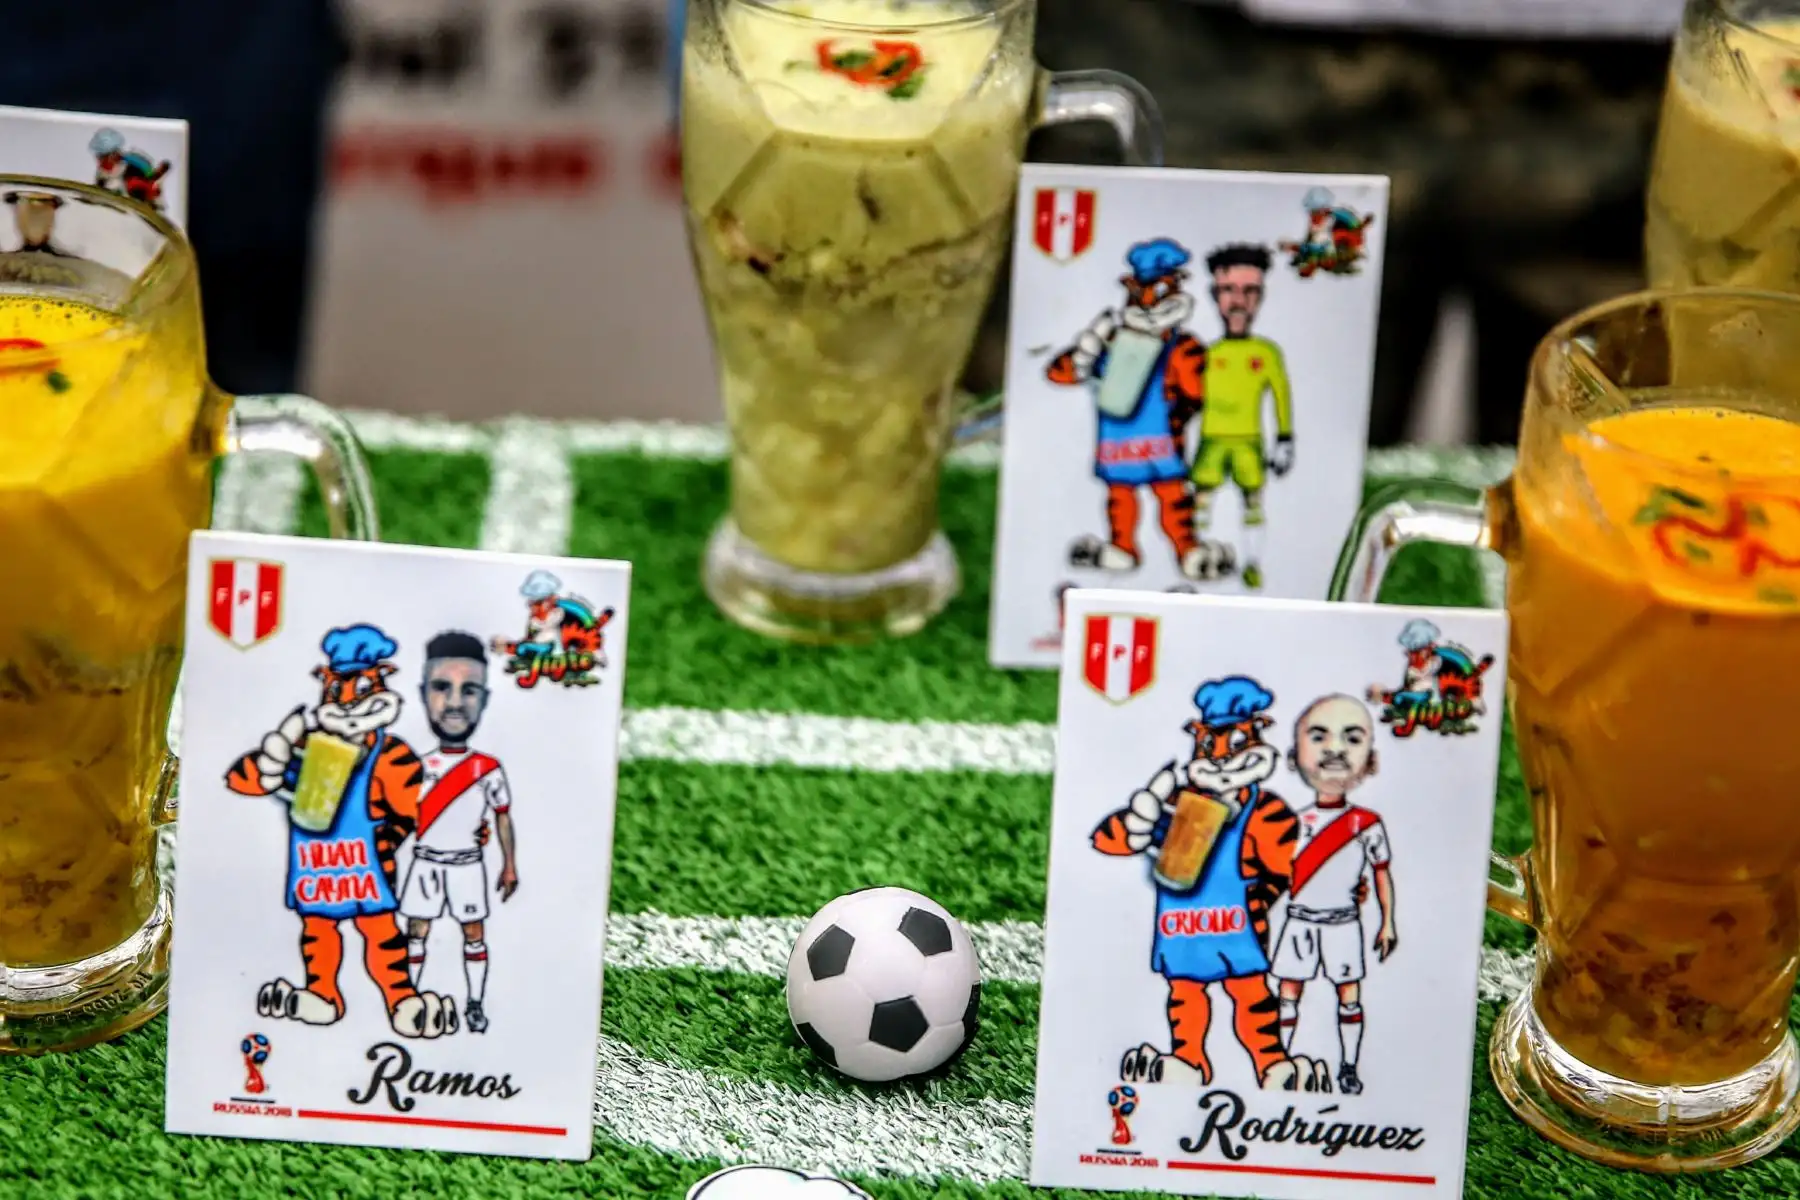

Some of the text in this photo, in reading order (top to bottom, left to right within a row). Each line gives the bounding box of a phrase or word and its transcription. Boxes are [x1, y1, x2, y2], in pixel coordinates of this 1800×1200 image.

[297, 838, 369, 870] HUAN
[1159, 904, 1248, 938] CRIOLLO
[1341, 963, 1351, 977] 2
[347, 1041, 522, 1113] Ramos
[1179, 1088, 1426, 1161] Rodríguez
[1079, 1153, 1128, 1167] RUSSIA
